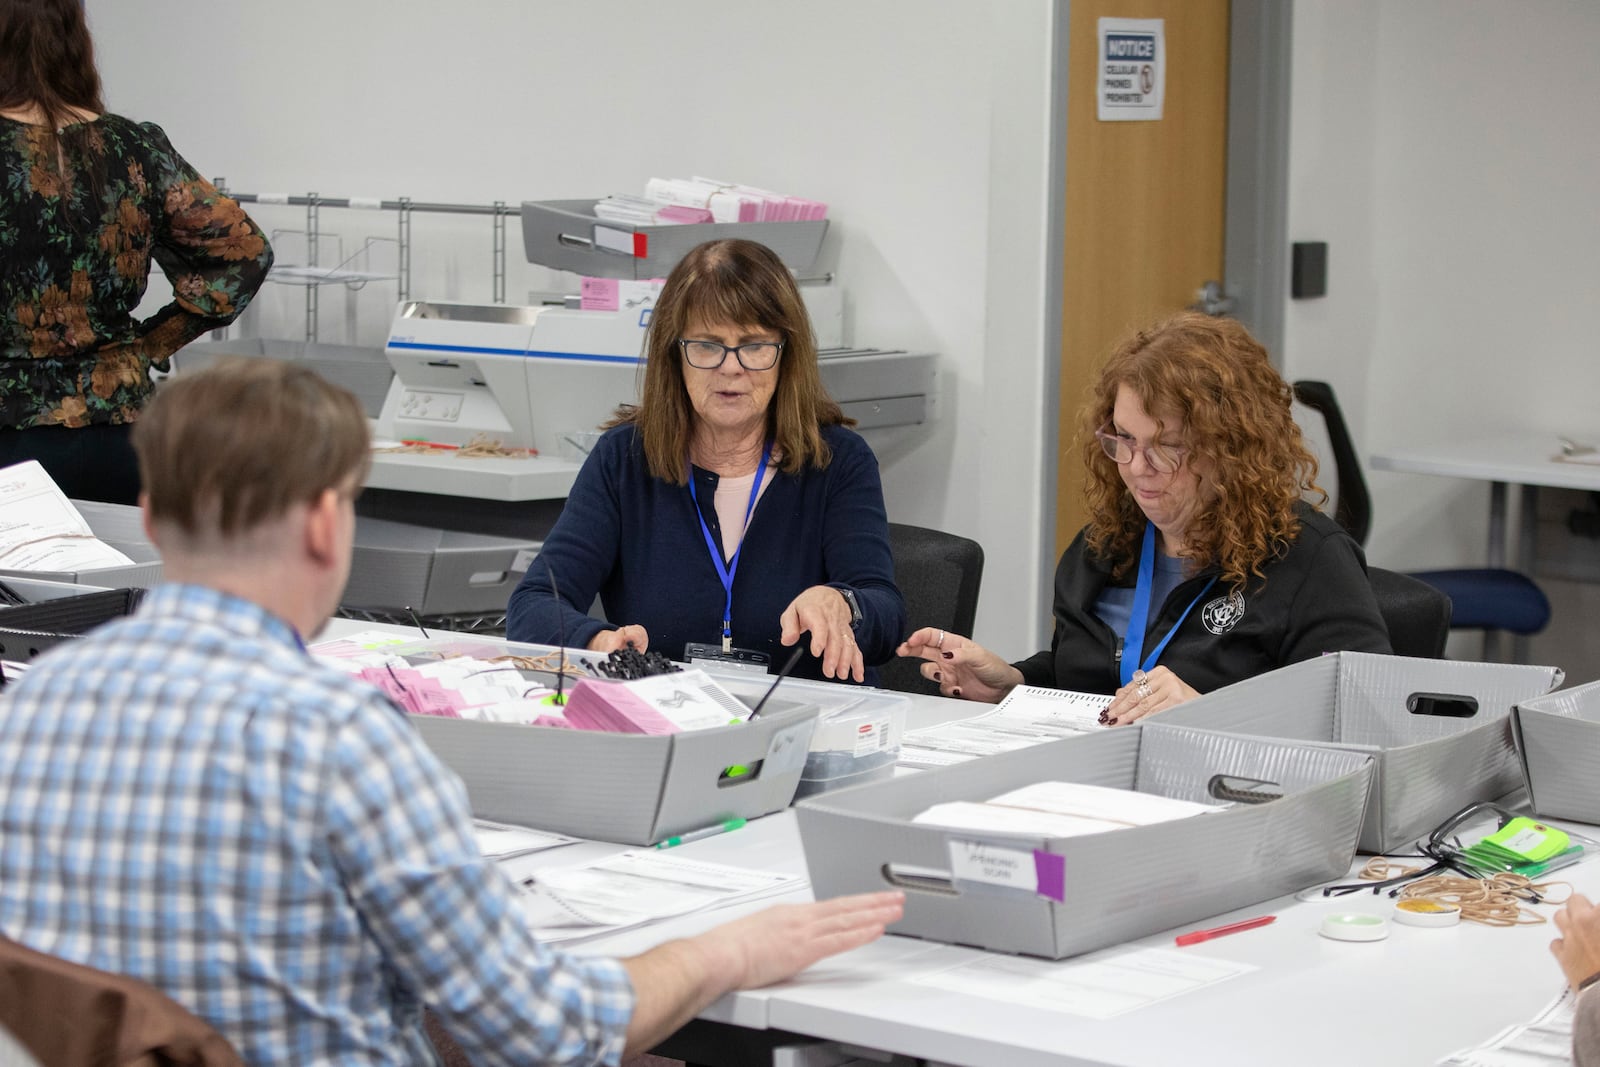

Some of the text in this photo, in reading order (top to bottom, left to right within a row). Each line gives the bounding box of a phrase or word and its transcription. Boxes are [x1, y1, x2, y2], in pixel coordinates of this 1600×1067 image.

[1108, 39, 1154, 57] NOTICE
[1106, 65, 1139, 75] CELLULAR
[1105, 79, 1132, 89] PHONES
